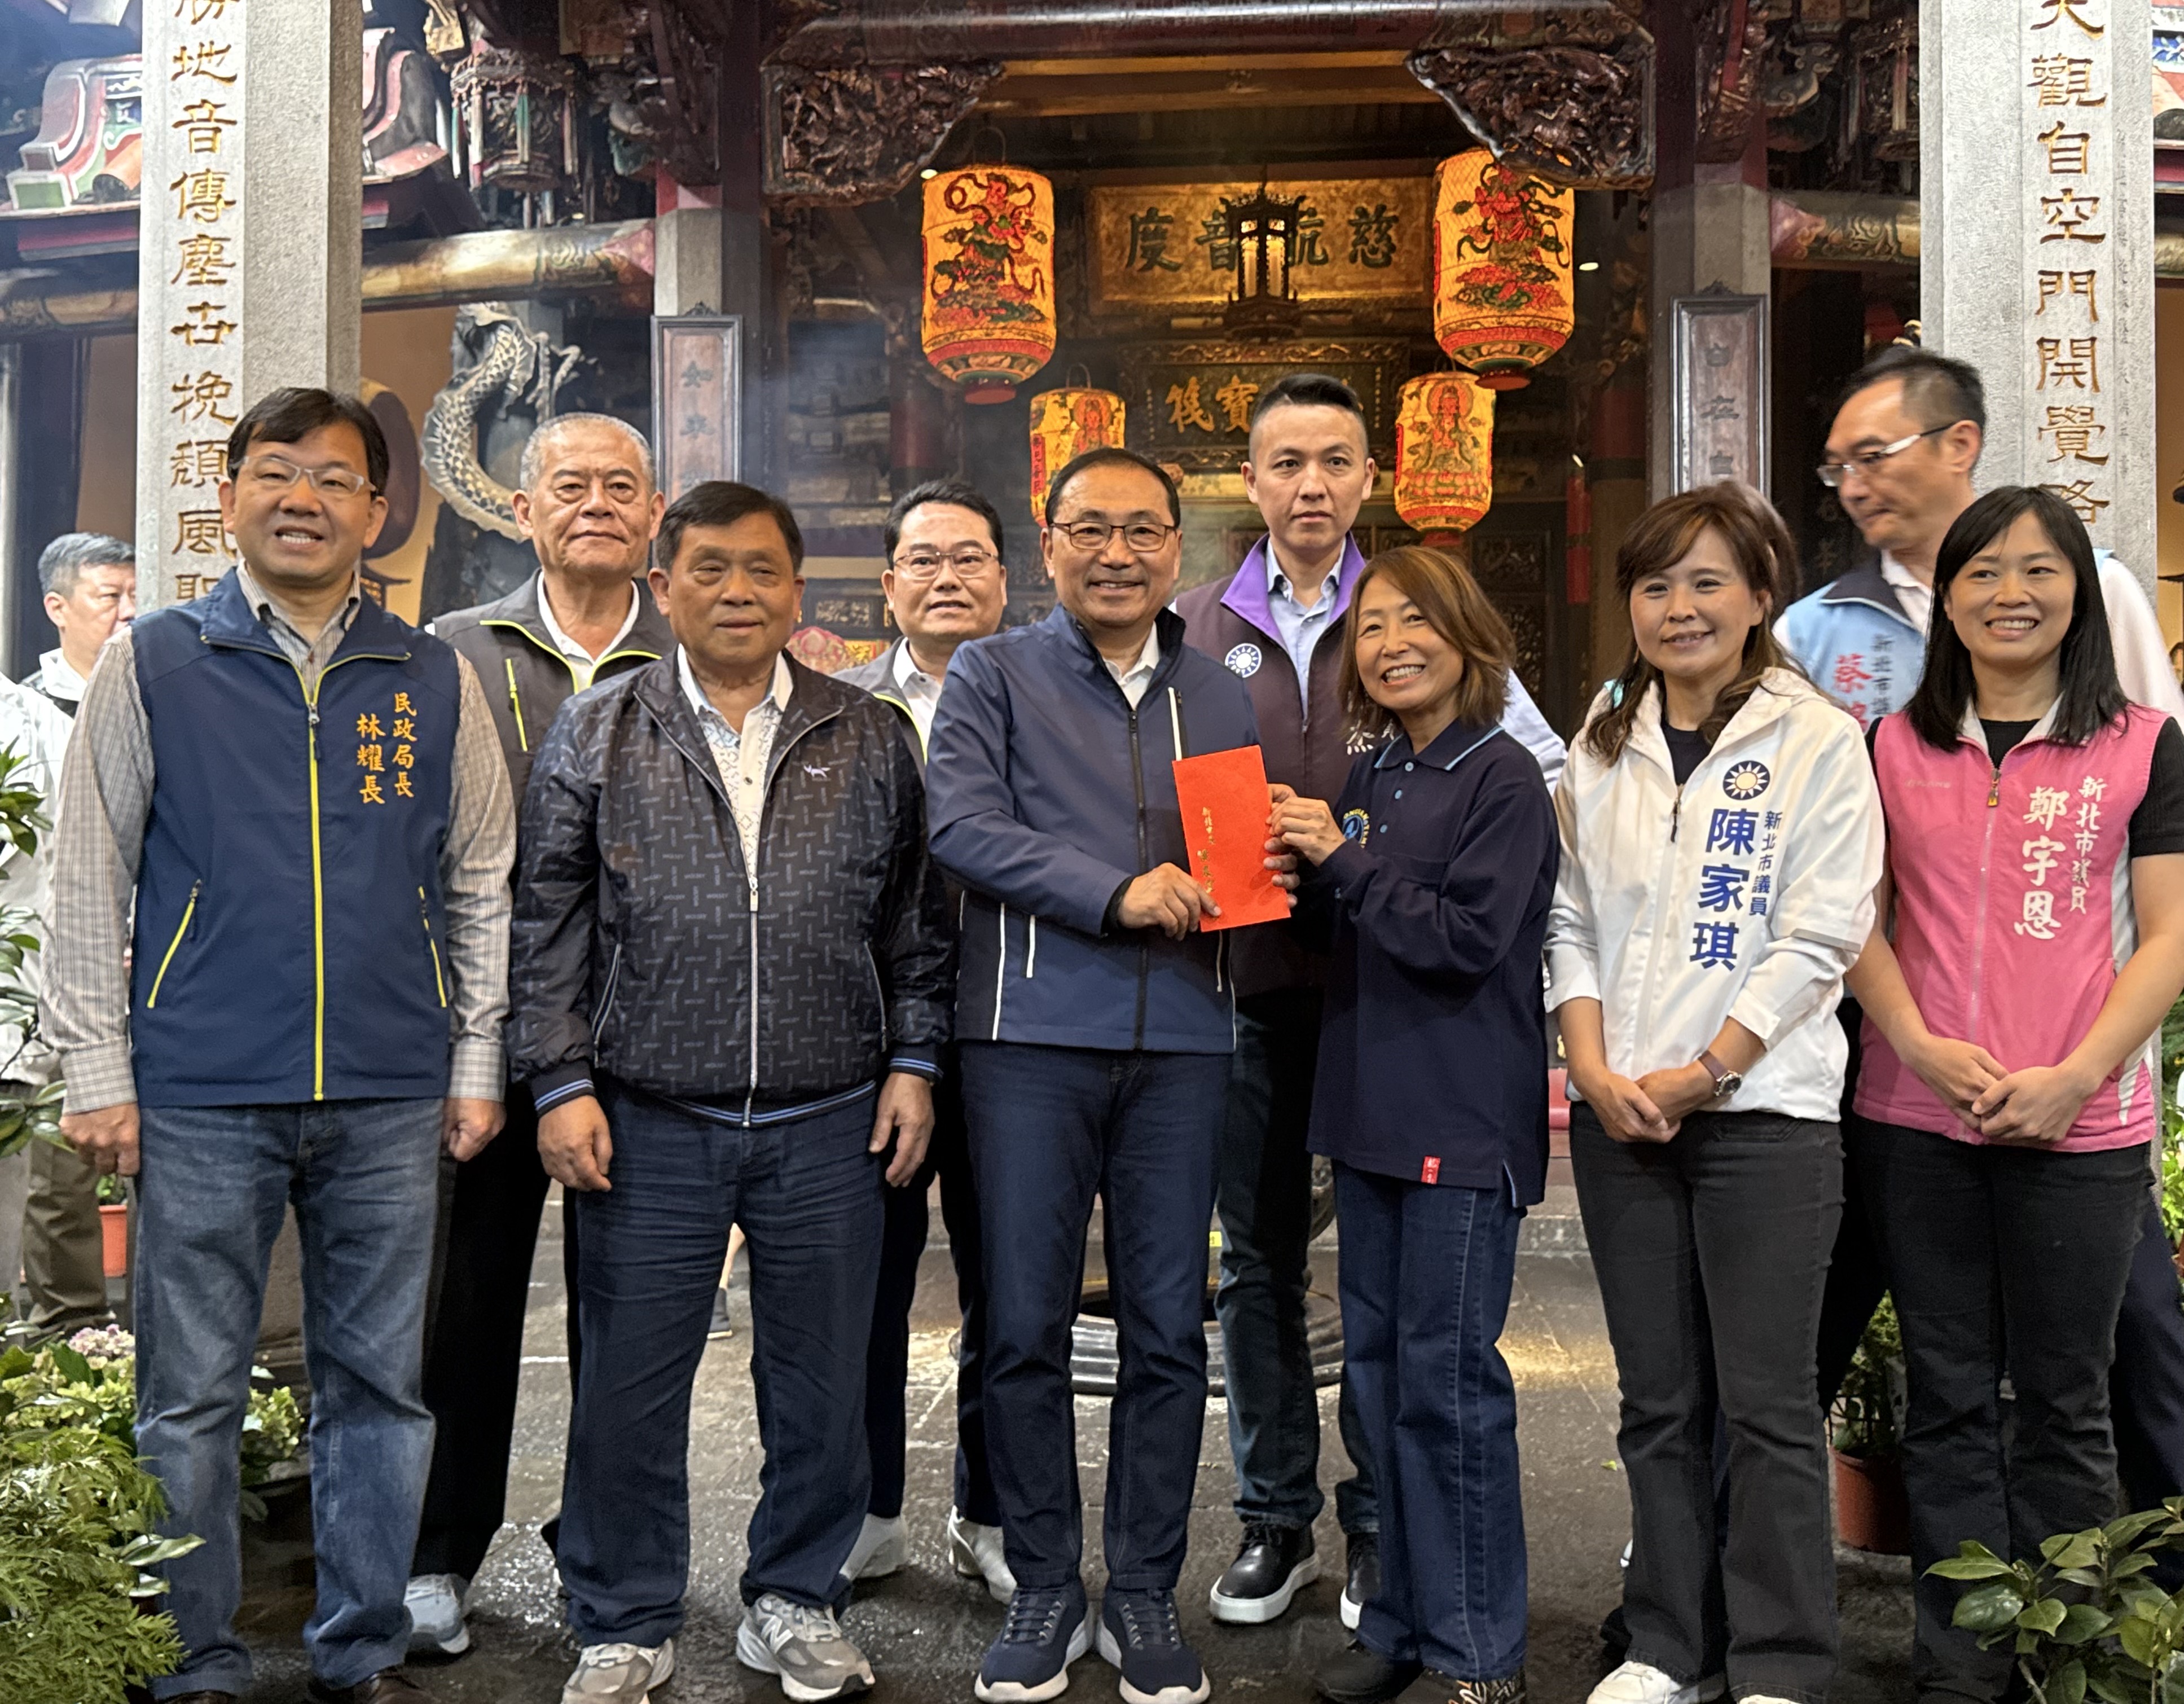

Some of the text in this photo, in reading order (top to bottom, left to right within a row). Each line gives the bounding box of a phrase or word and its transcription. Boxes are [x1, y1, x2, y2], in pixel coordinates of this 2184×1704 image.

[356, 713, 386, 805] 林耀長
[392, 692, 418, 798] 民政局長
[1689, 808, 1760, 972] 陳家琪
[1749, 810, 1783, 916] 新北市議員
[2013, 785, 2071, 939] 鄭宇恩
[2069, 775, 2108, 915] 新北市議員
